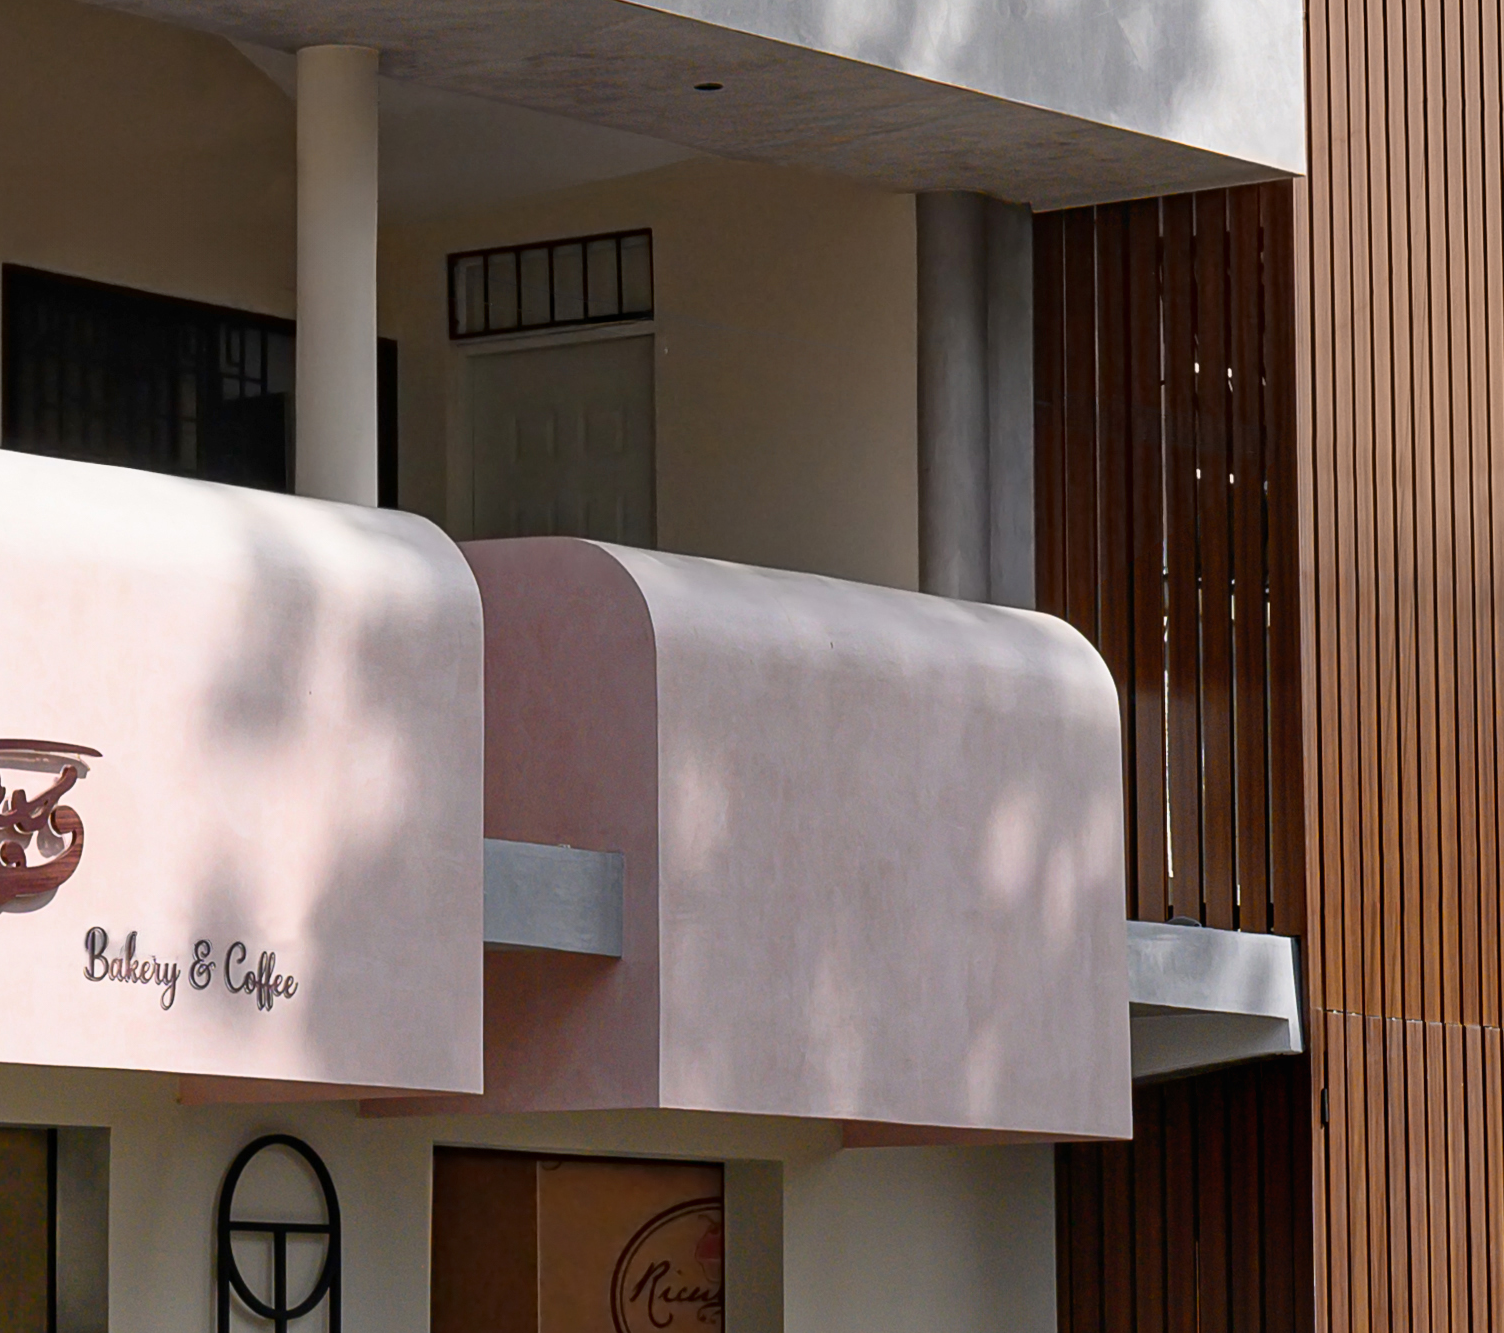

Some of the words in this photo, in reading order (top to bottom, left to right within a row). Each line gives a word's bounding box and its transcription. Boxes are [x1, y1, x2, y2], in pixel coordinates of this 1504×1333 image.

[83, 926, 181, 1010] Bakery
[189, 938, 217, 991] &
[224, 941, 299, 1012] Coffee
